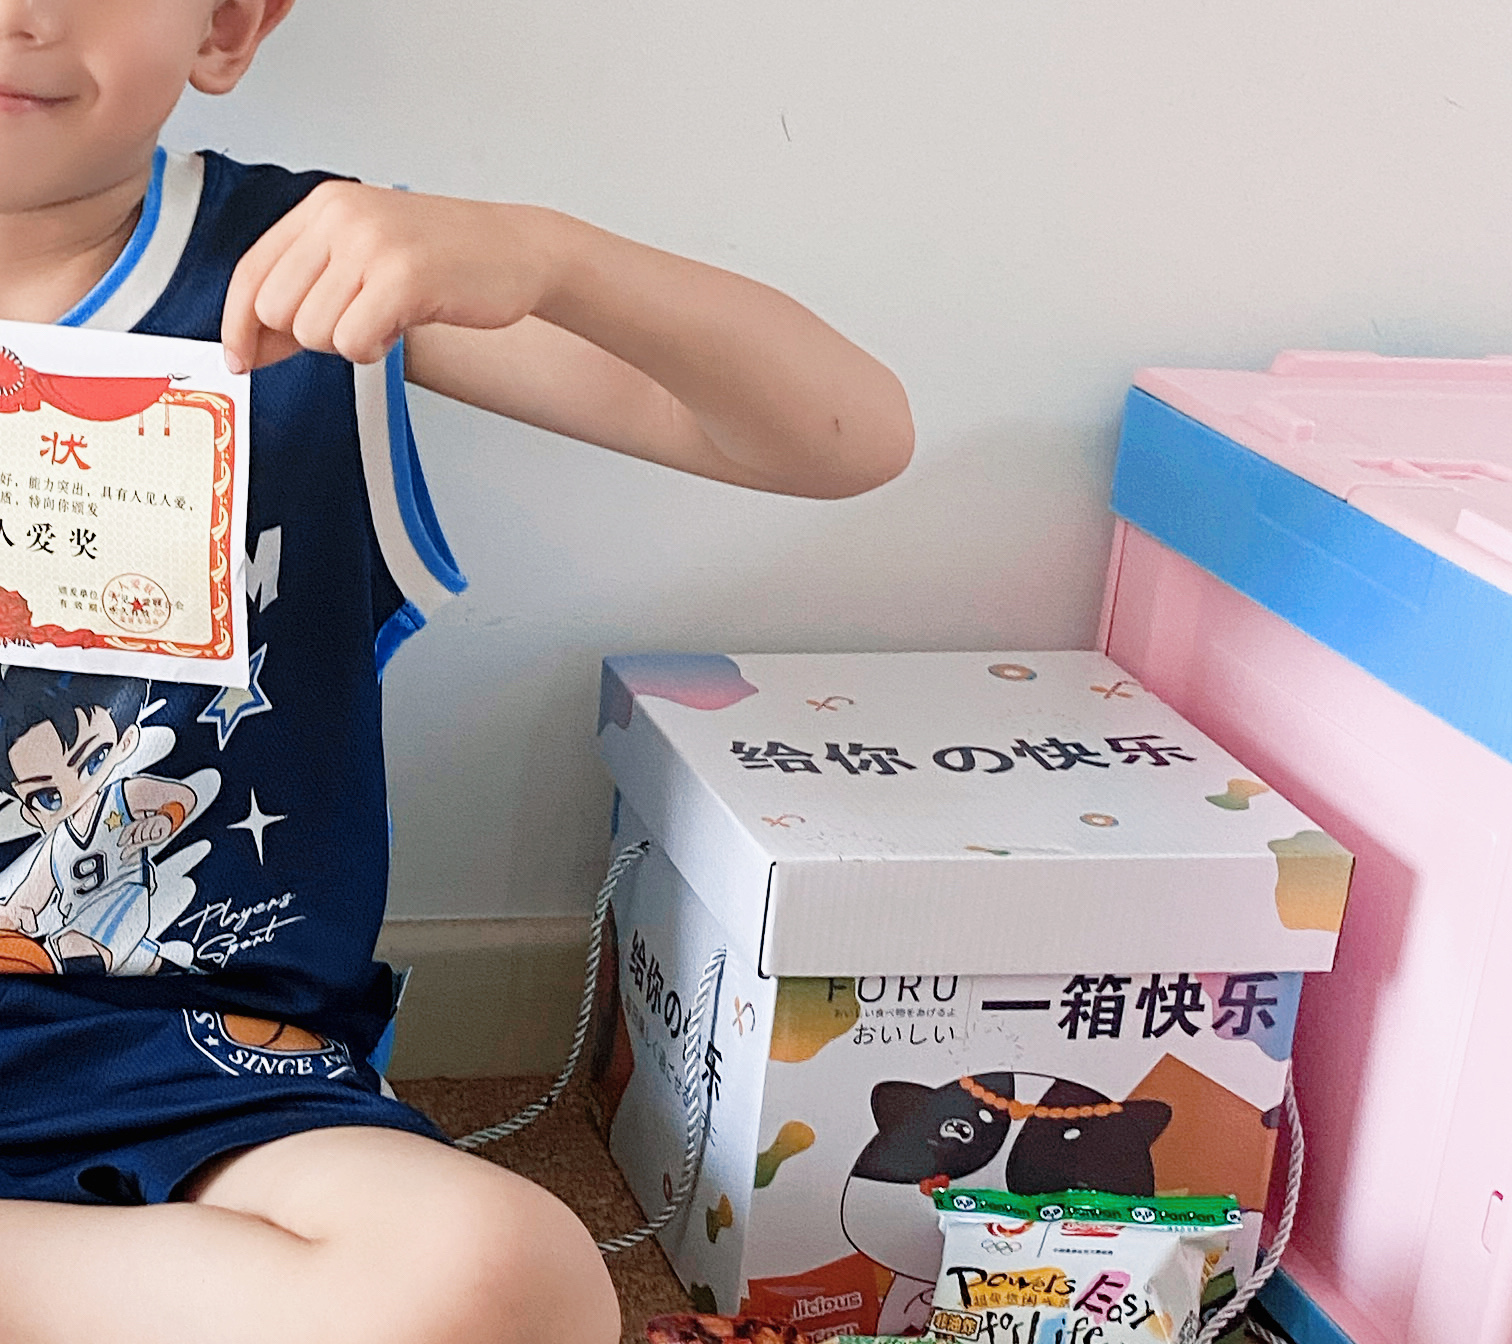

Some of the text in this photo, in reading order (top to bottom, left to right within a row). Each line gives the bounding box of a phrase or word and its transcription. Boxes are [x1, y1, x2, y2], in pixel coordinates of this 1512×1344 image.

[70, 853, 107, 896] 9
[981, 972, 1280, 1041] 一箱快乐
[852, 1022, 956, 1047] おいしい
[228, 1048, 314, 1077] SINCE
[946, 1266, 1077, 1309] Powers
